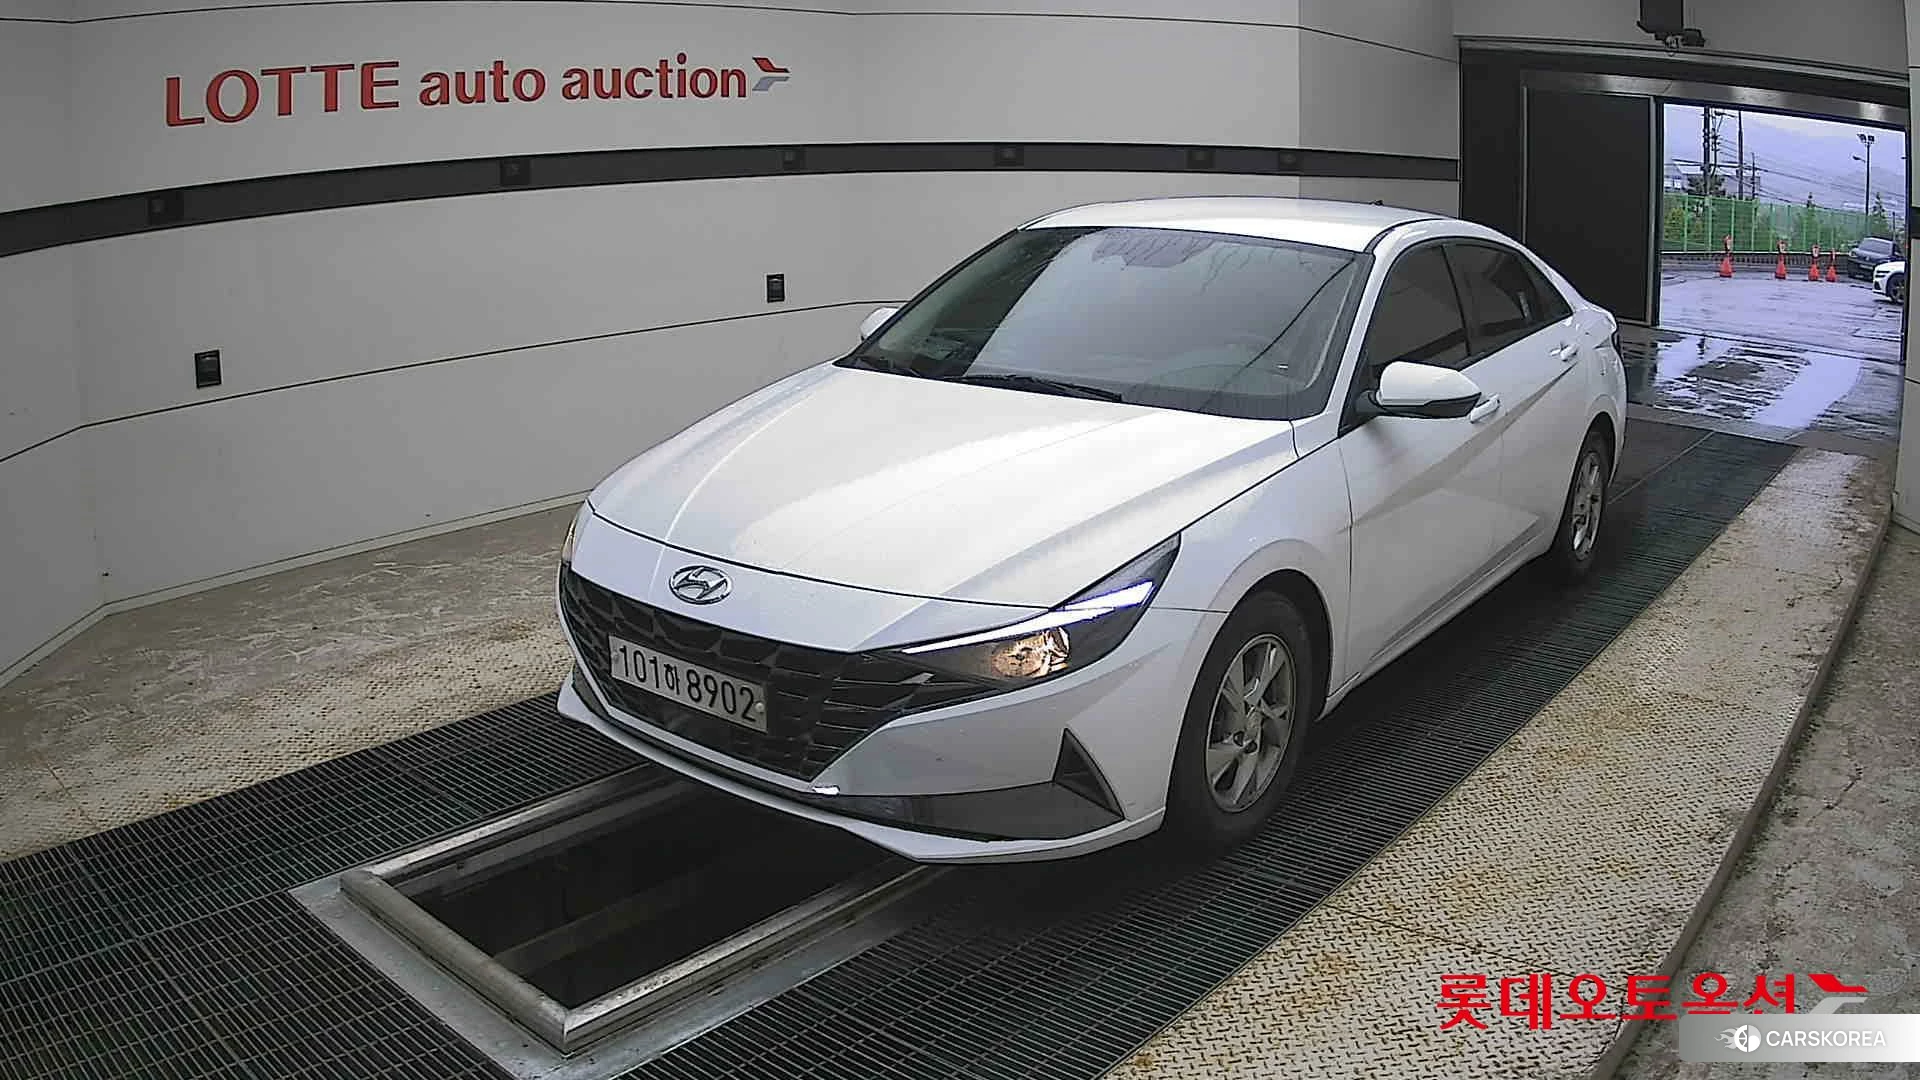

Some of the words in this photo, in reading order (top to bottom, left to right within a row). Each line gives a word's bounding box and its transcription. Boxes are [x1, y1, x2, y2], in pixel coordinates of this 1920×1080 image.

[165, 60, 400, 127] LOTTE
[419, 60, 547, 105] auto
[561, 53, 747, 100] auction
